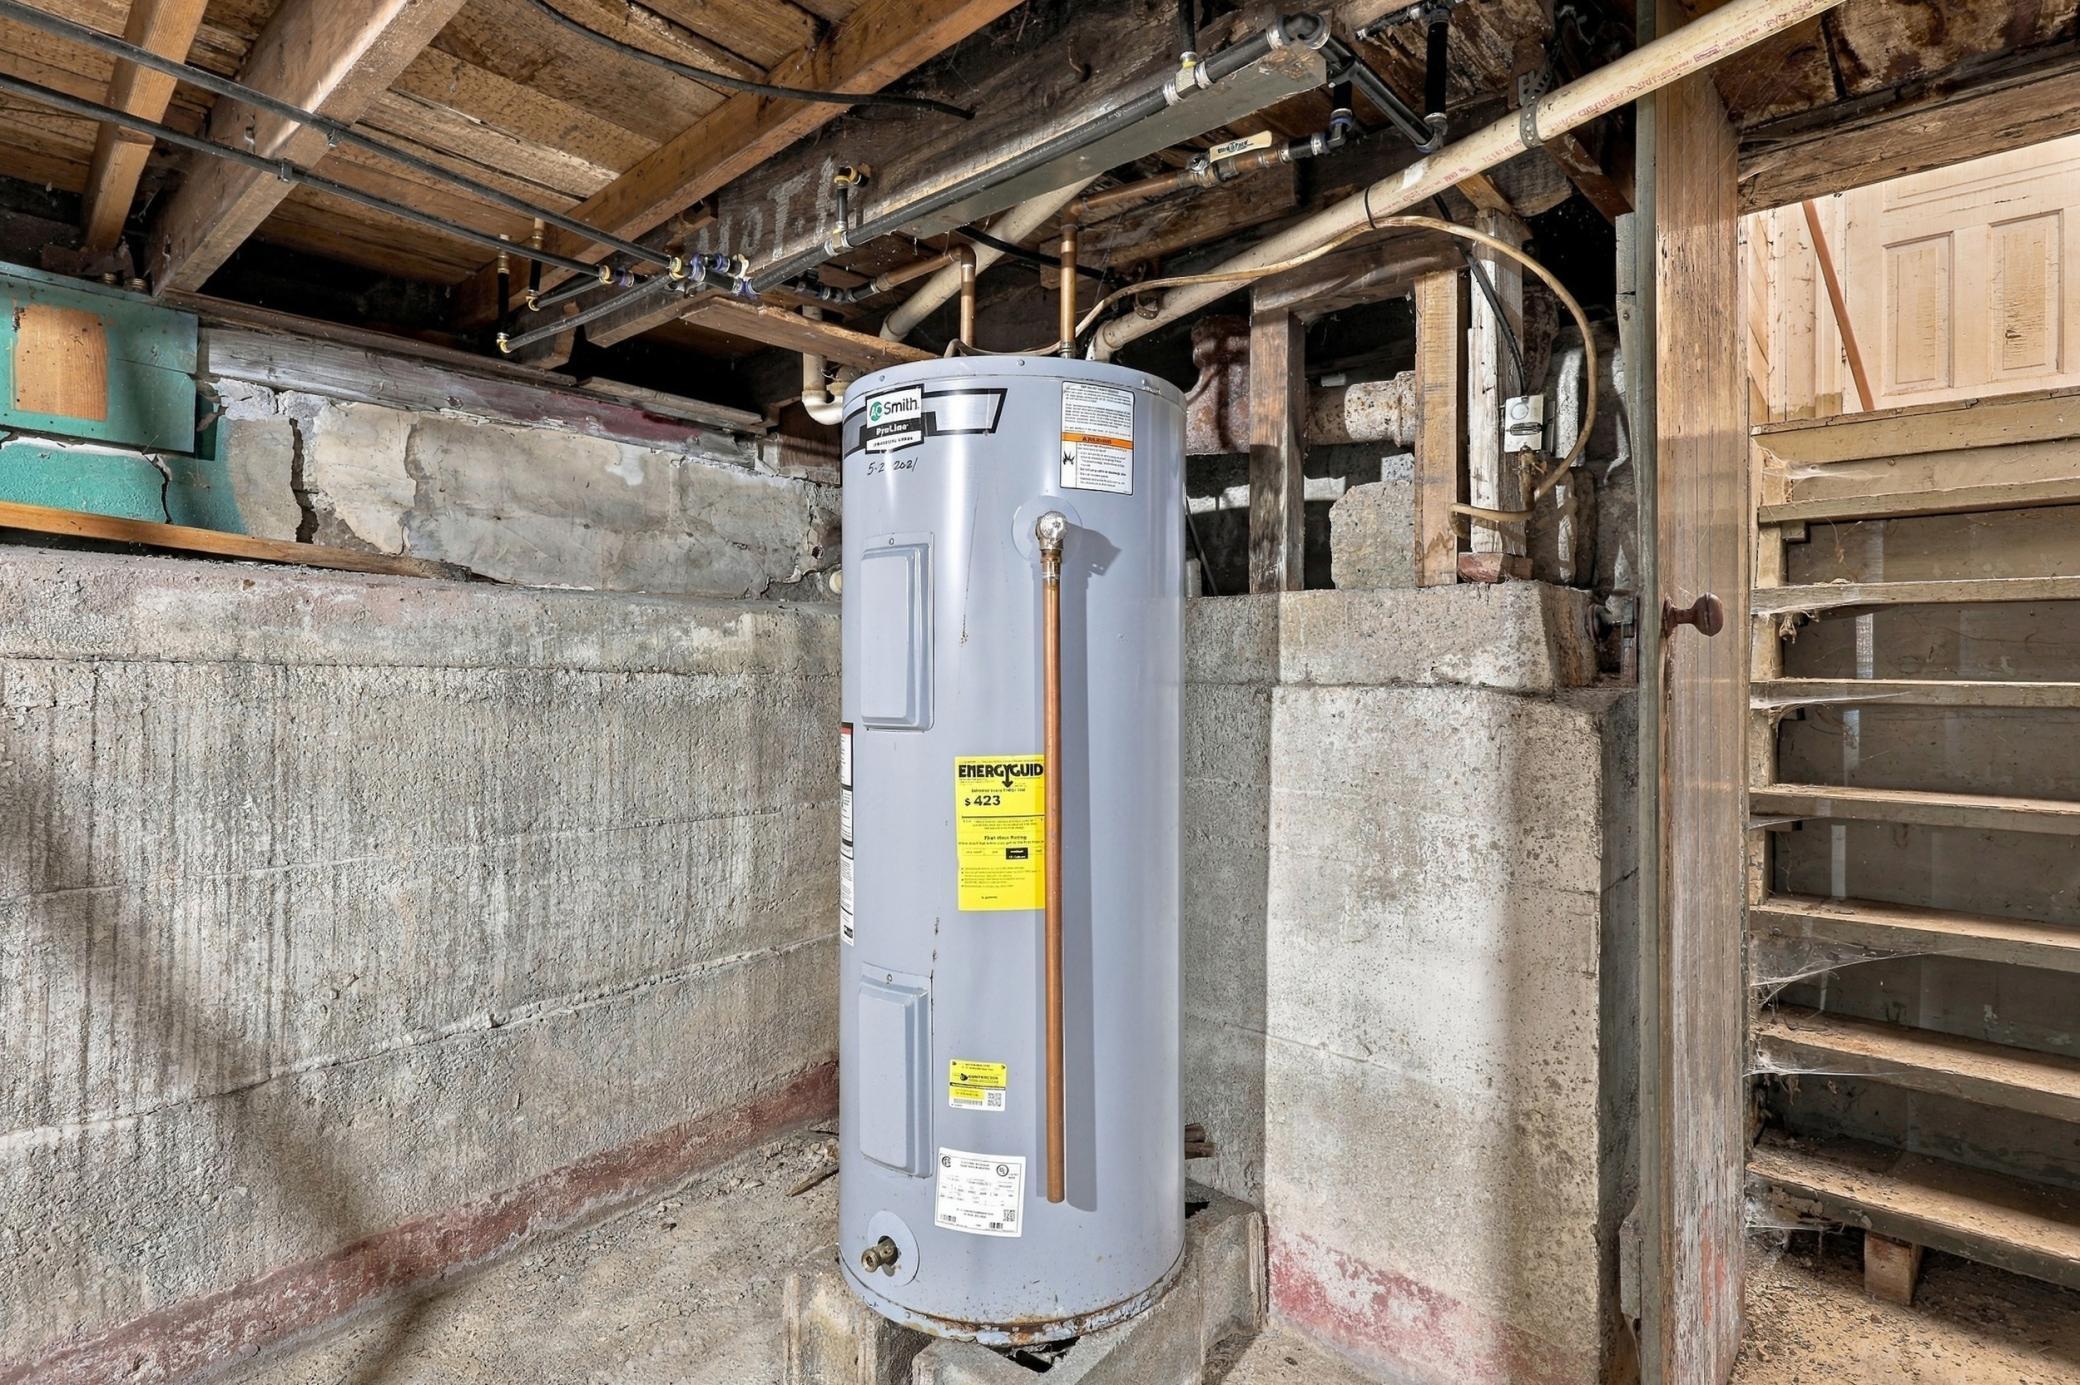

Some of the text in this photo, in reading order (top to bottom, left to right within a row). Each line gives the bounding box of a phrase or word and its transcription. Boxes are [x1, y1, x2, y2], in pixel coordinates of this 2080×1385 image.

[883, 397, 918, 415] Smith
[958, 763, 1044, 778] ENERGYGUID
[973, 794, 1001, 806] 423
